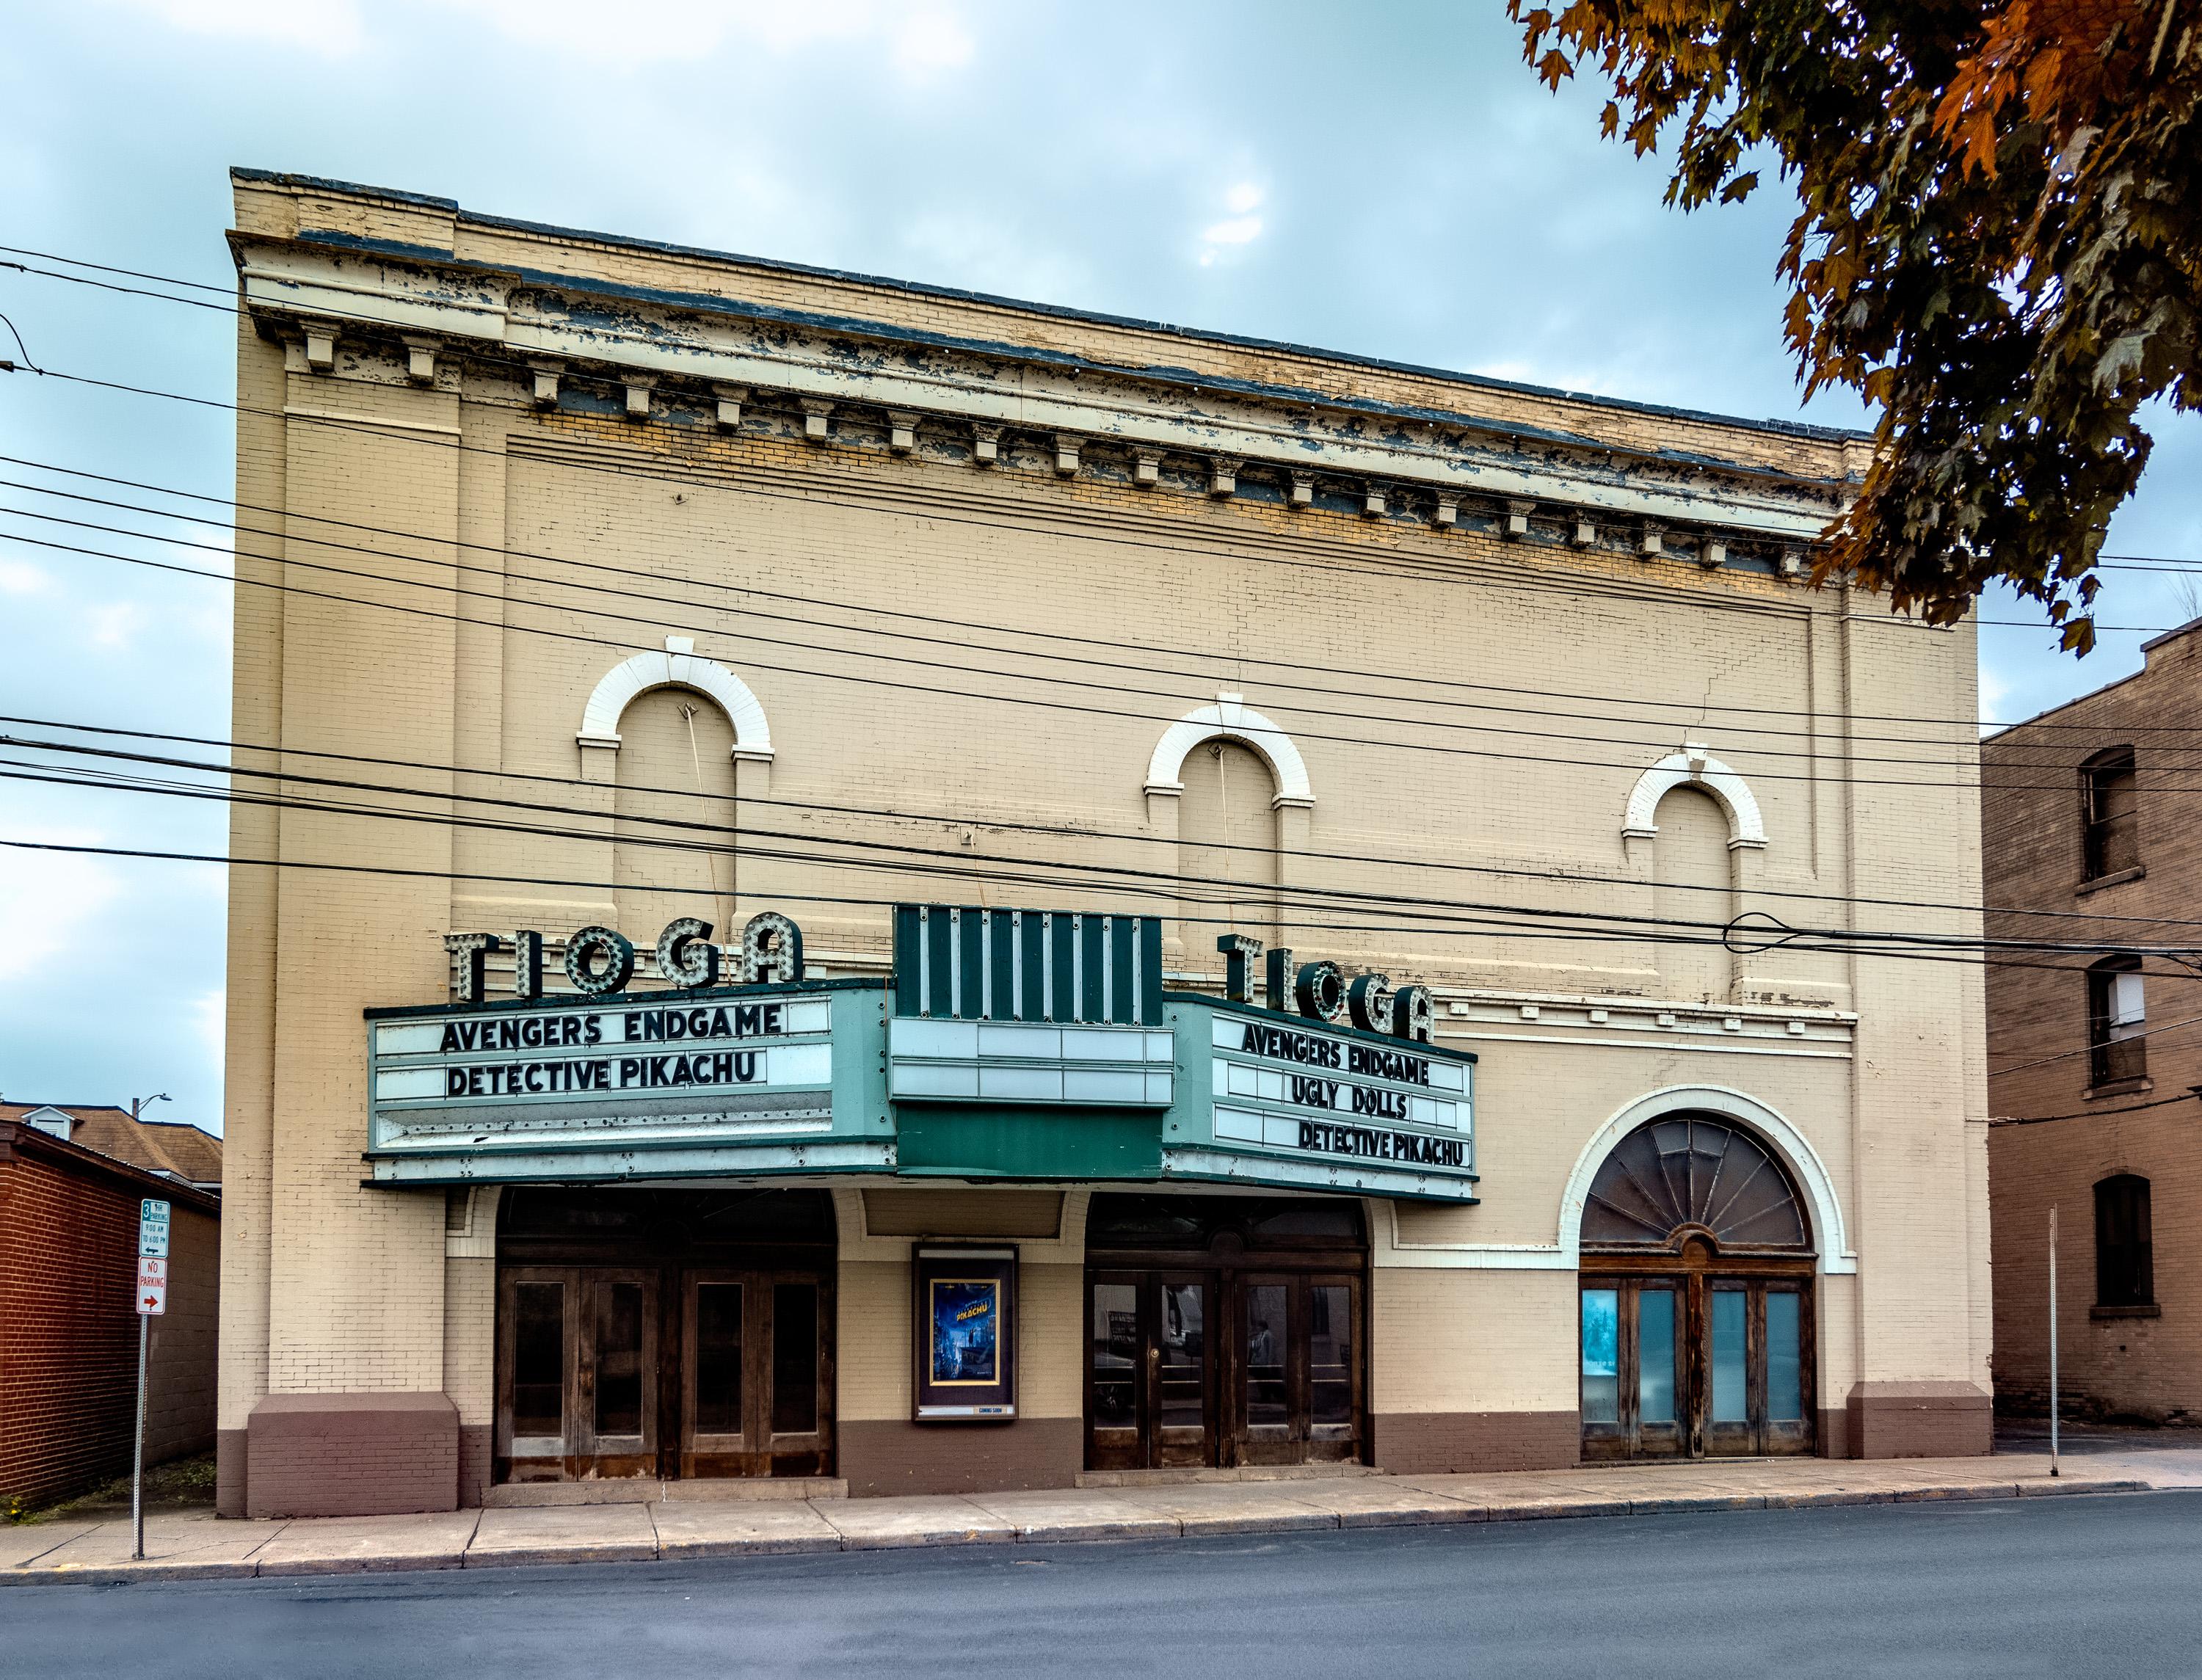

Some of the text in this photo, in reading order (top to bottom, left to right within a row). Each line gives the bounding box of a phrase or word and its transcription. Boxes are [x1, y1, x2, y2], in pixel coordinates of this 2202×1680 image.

[443, 912, 804, 1003] TIOGA
[1217, 934, 1434, 1044] TIOGA
[440, 1004, 781, 1051] AVENGERS ENDGAME
[447, 1052, 755, 1095] DETECTIVE PIKACHU
[1241, 1023, 1429, 1086] AVENGERS ENDGAME
[1291, 1075, 1407, 1119] UGLY DOLLS
[1298, 1121, 1464, 1166] DETECTIVE PIKACHU
[143, 1204, 150, 1218] 3
[150, 1212, 167, 1221] PARKING
[142, 1234, 148, 1243] TO
[140, 1276, 164, 1288] PARKING
[148, 1262, 158, 1273] NO
[956, 1303, 988, 1322] PIKACHU
